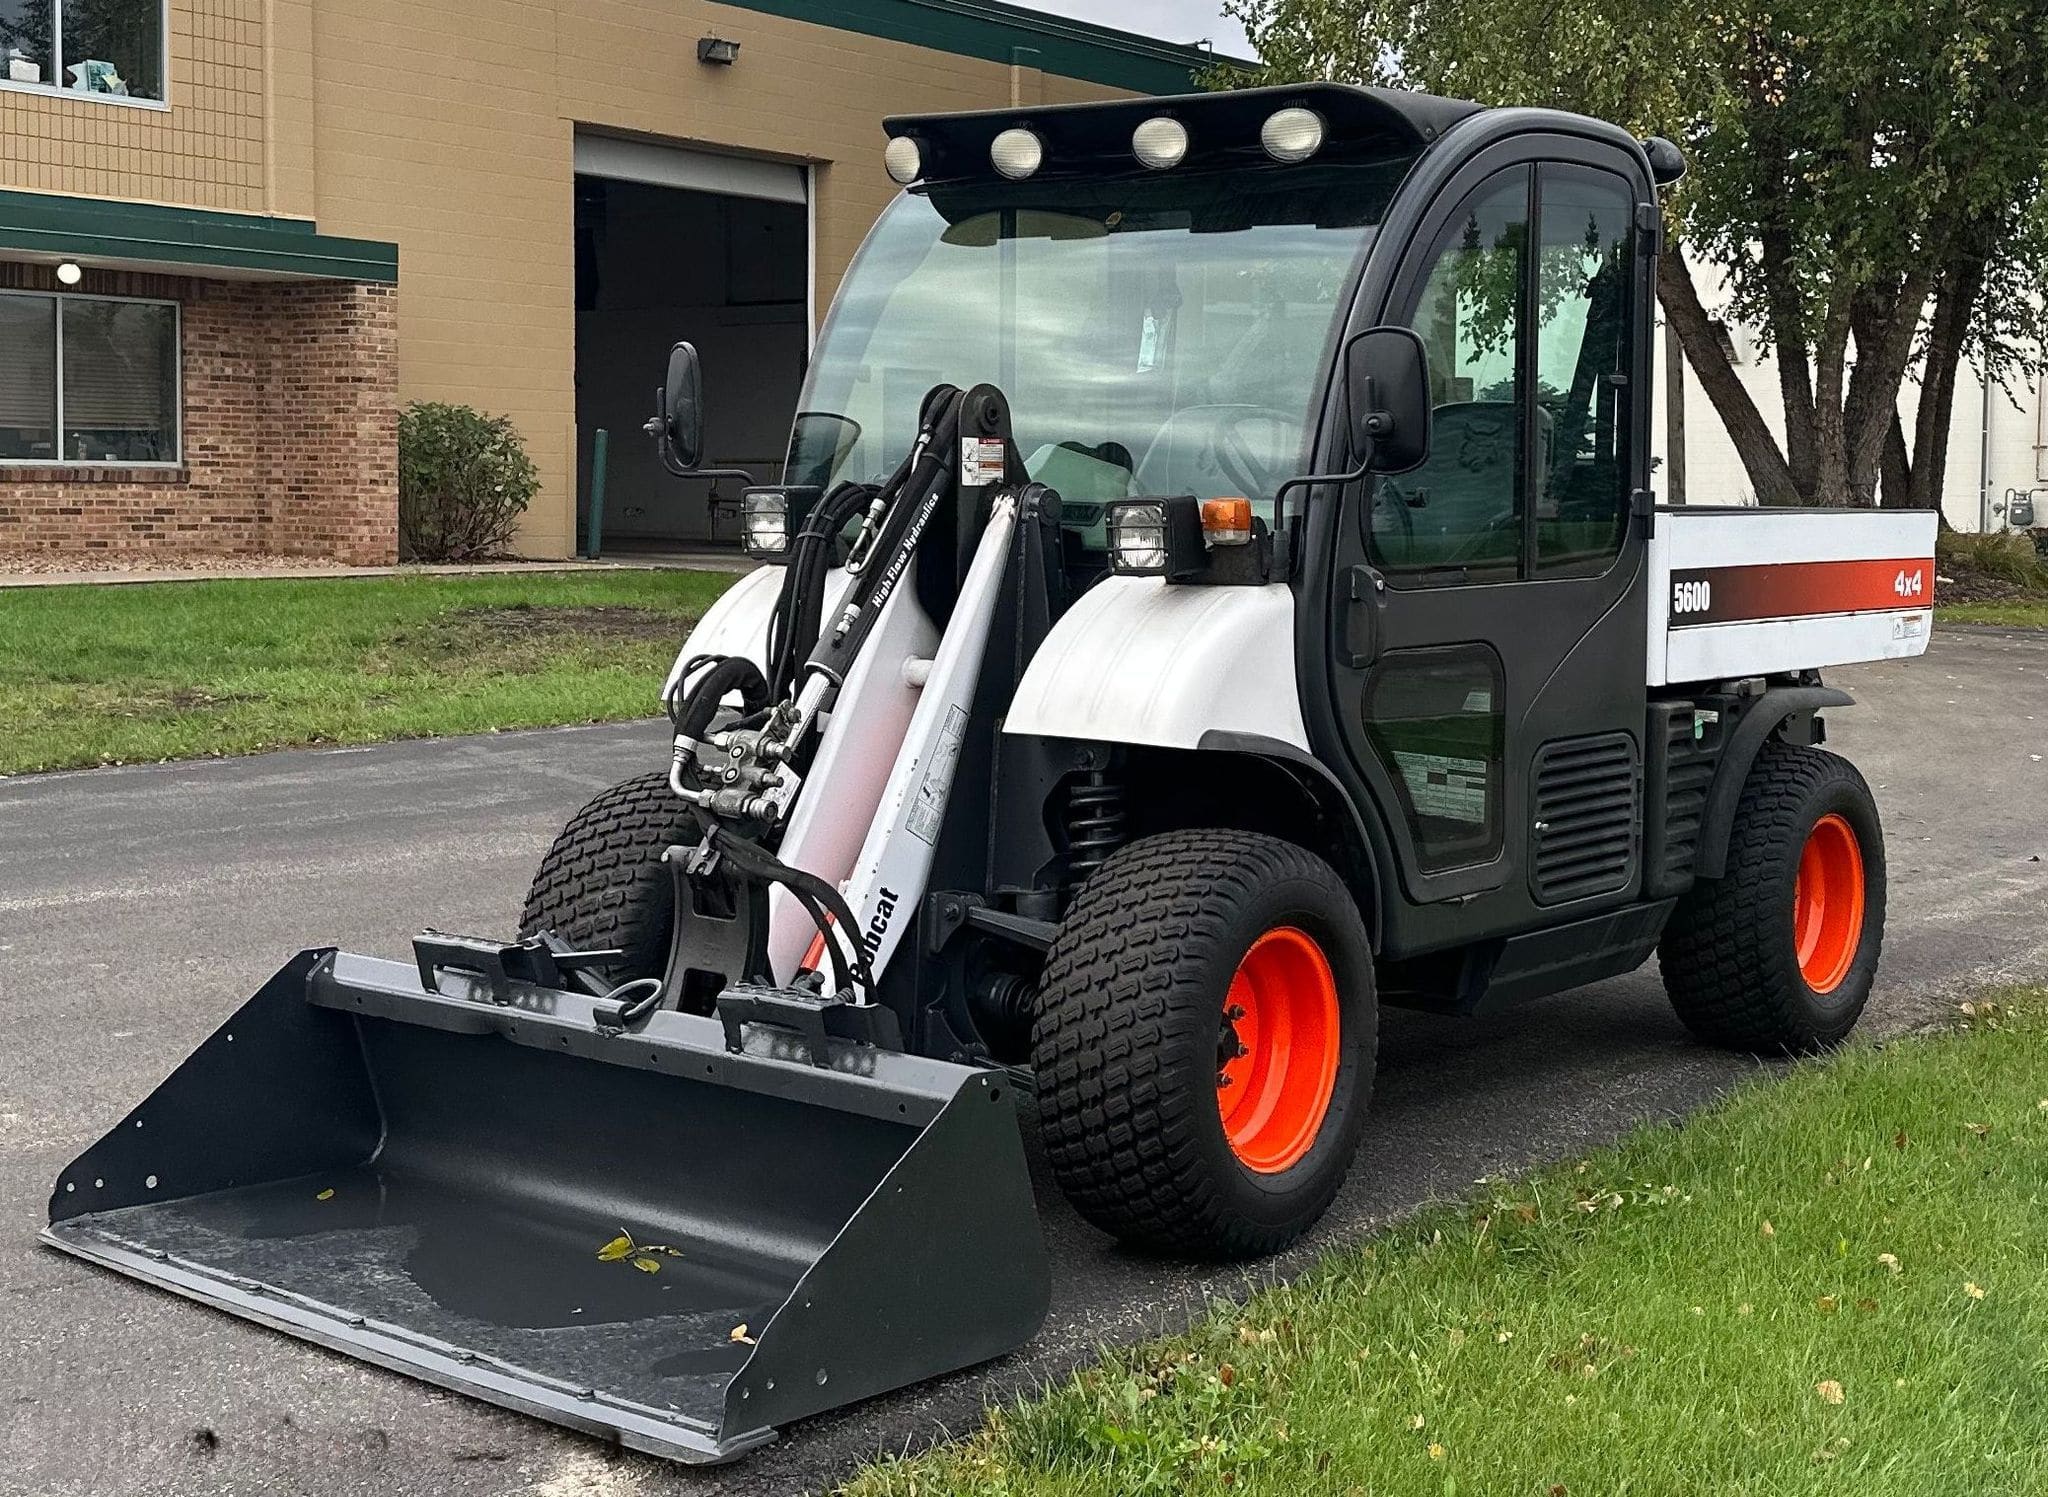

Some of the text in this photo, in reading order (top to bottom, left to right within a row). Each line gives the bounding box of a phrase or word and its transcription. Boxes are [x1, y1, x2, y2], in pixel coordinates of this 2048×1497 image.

[872, 493, 939, 608] High Flow Hydraulics
[1674, 581, 1711, 613] 5600
[1894, 570, 1923, 597] 4x4
